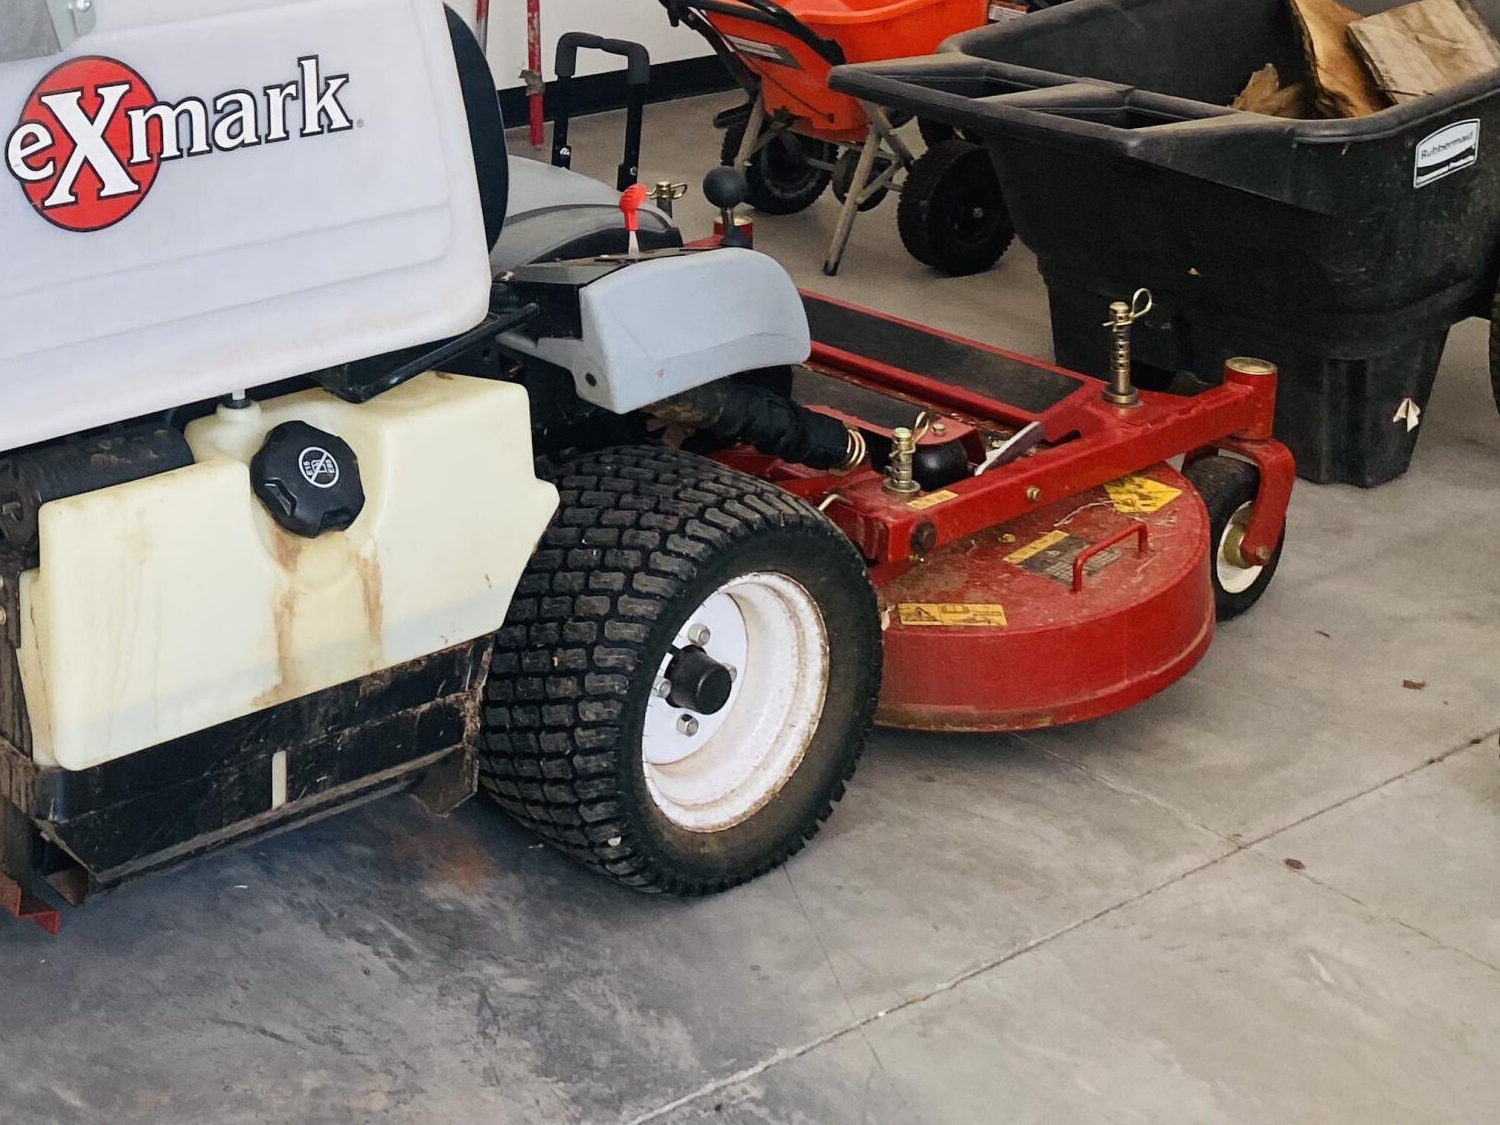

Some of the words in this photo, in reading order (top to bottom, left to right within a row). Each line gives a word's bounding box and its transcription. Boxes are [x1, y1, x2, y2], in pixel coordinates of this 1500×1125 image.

[4, 55, 354, 210] eXmark
[1420, 130, 1474, 160] Rubbermaid
[303, 460, 314, 476] E15
